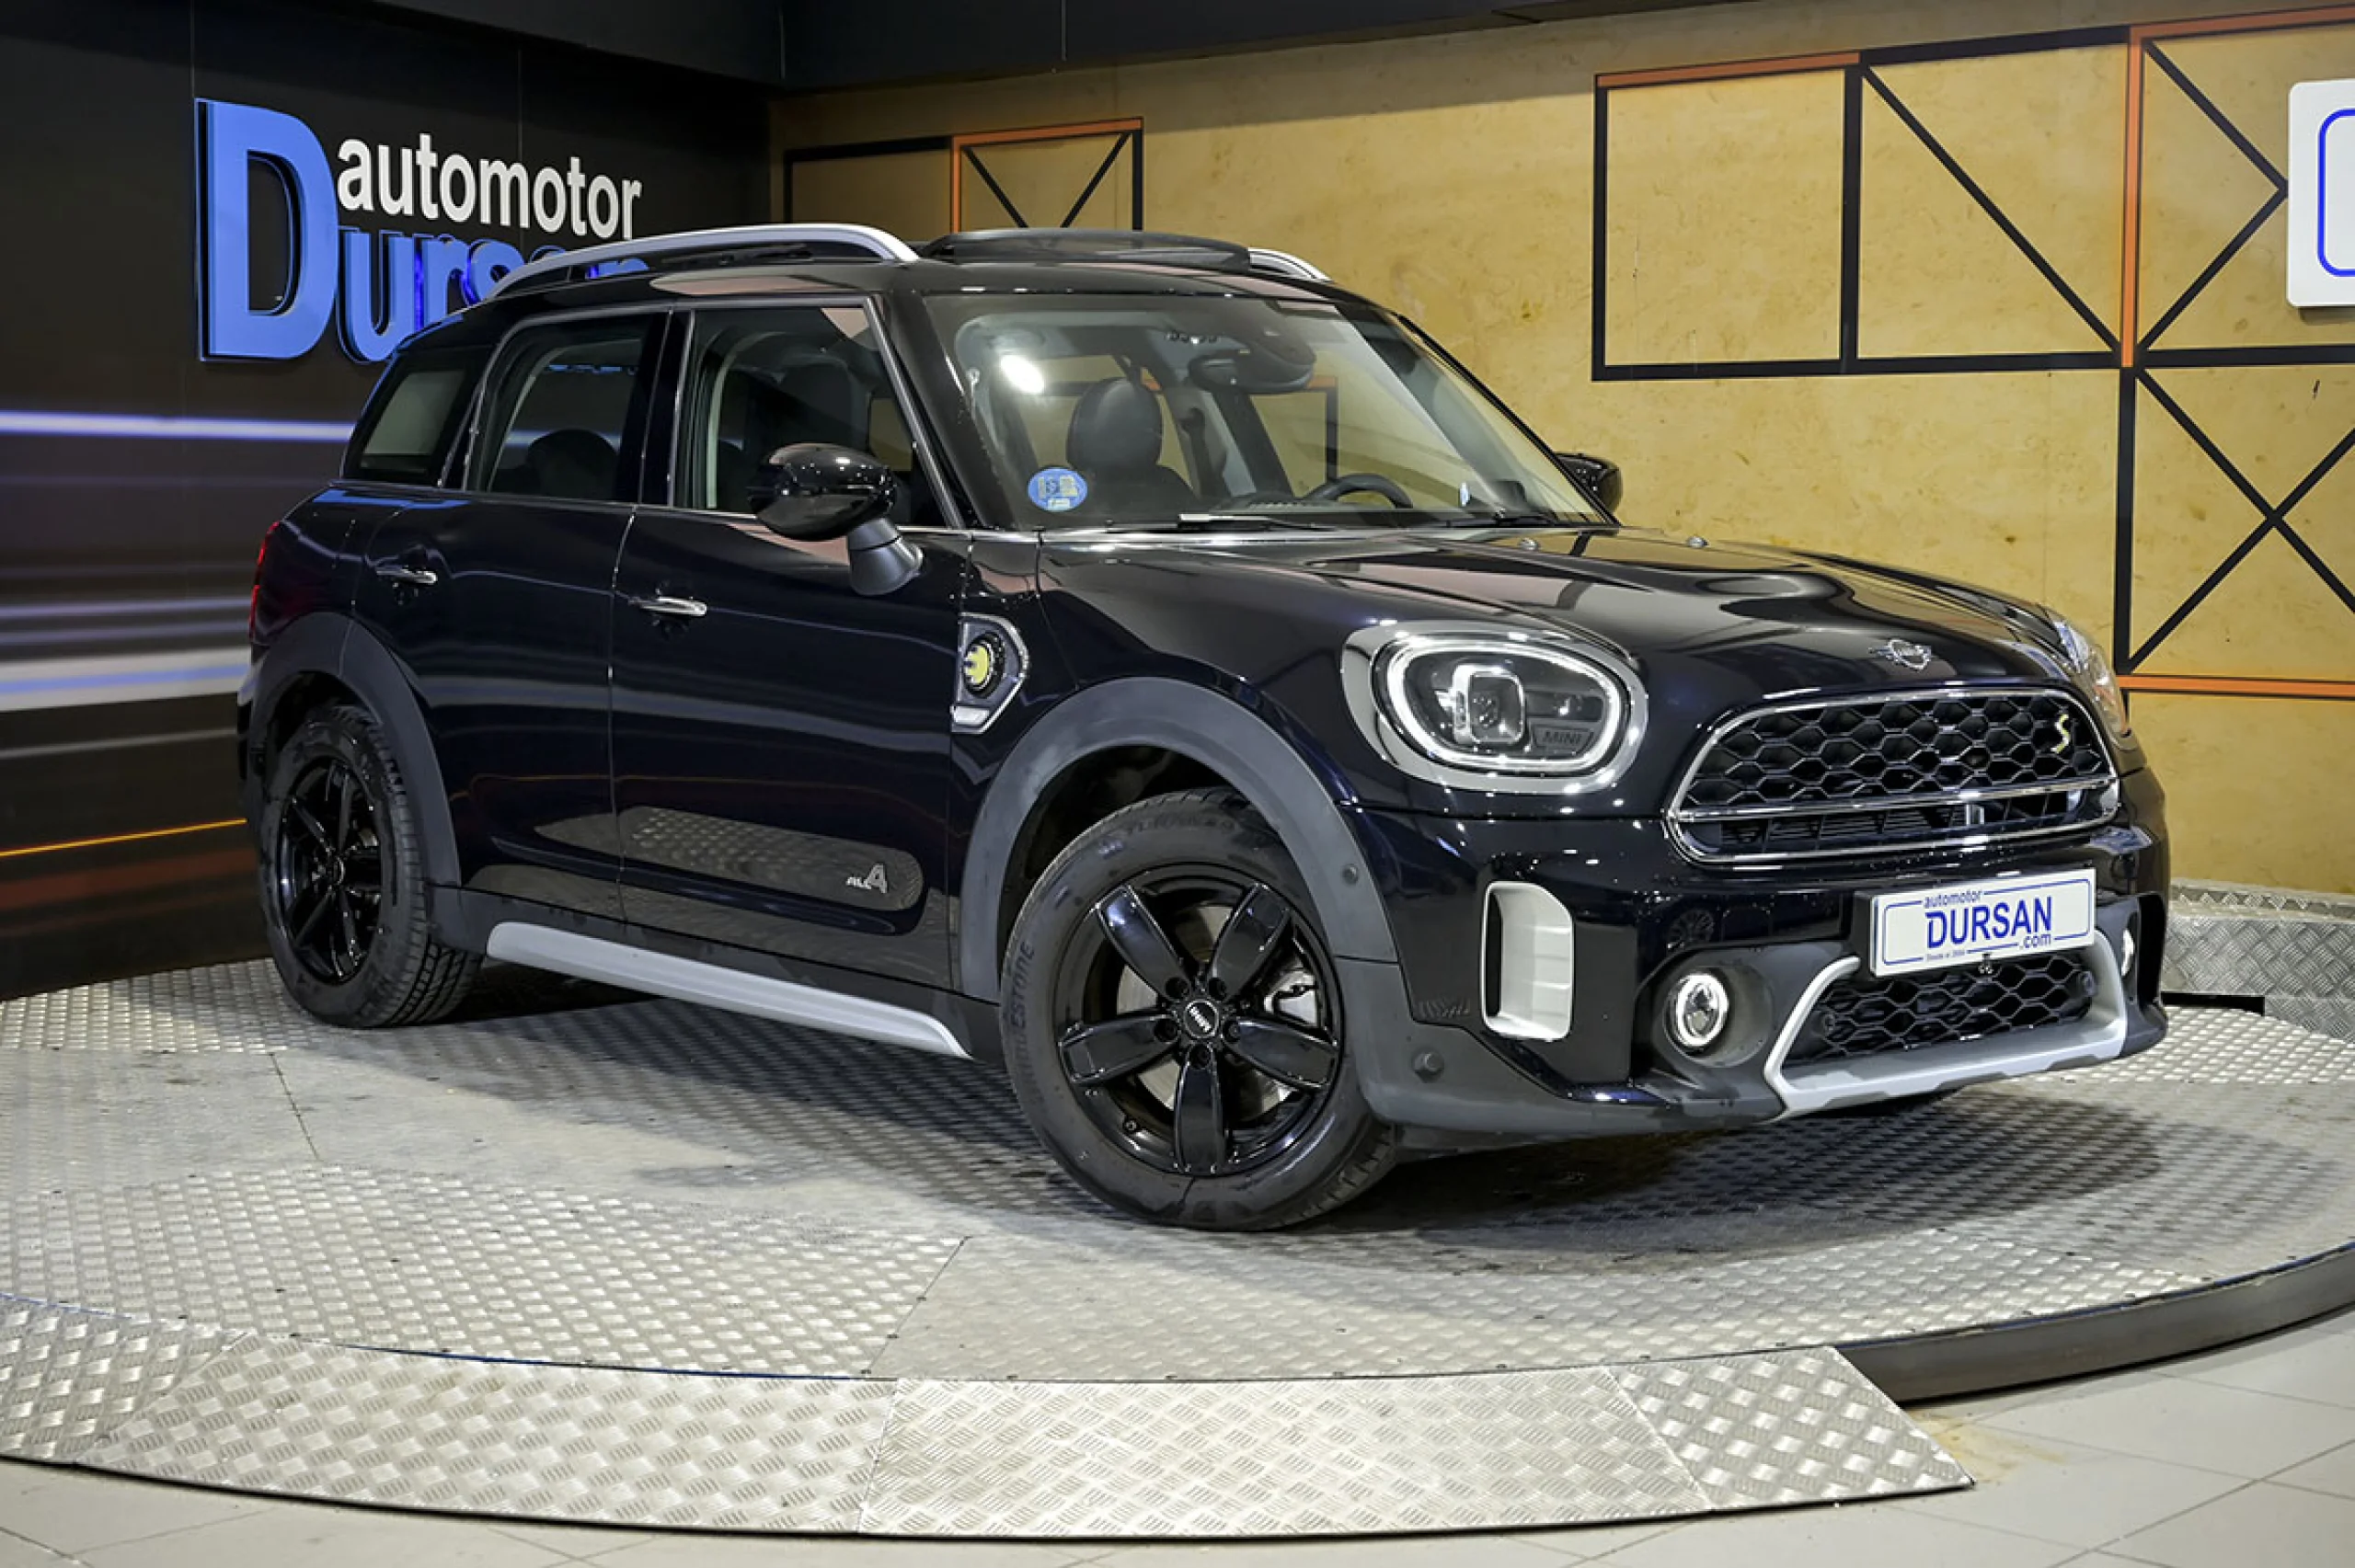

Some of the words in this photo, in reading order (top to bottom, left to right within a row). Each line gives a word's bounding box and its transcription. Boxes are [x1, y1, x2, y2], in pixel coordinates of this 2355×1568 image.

[337, 132, 643, 239] automotor
[194, 97, 649, 363] Durs
[1924, 889, 1982, 909] automotor
[1924, 896, 2052, 949] DURSAN
[2019, 933, 2051, 949] .com
